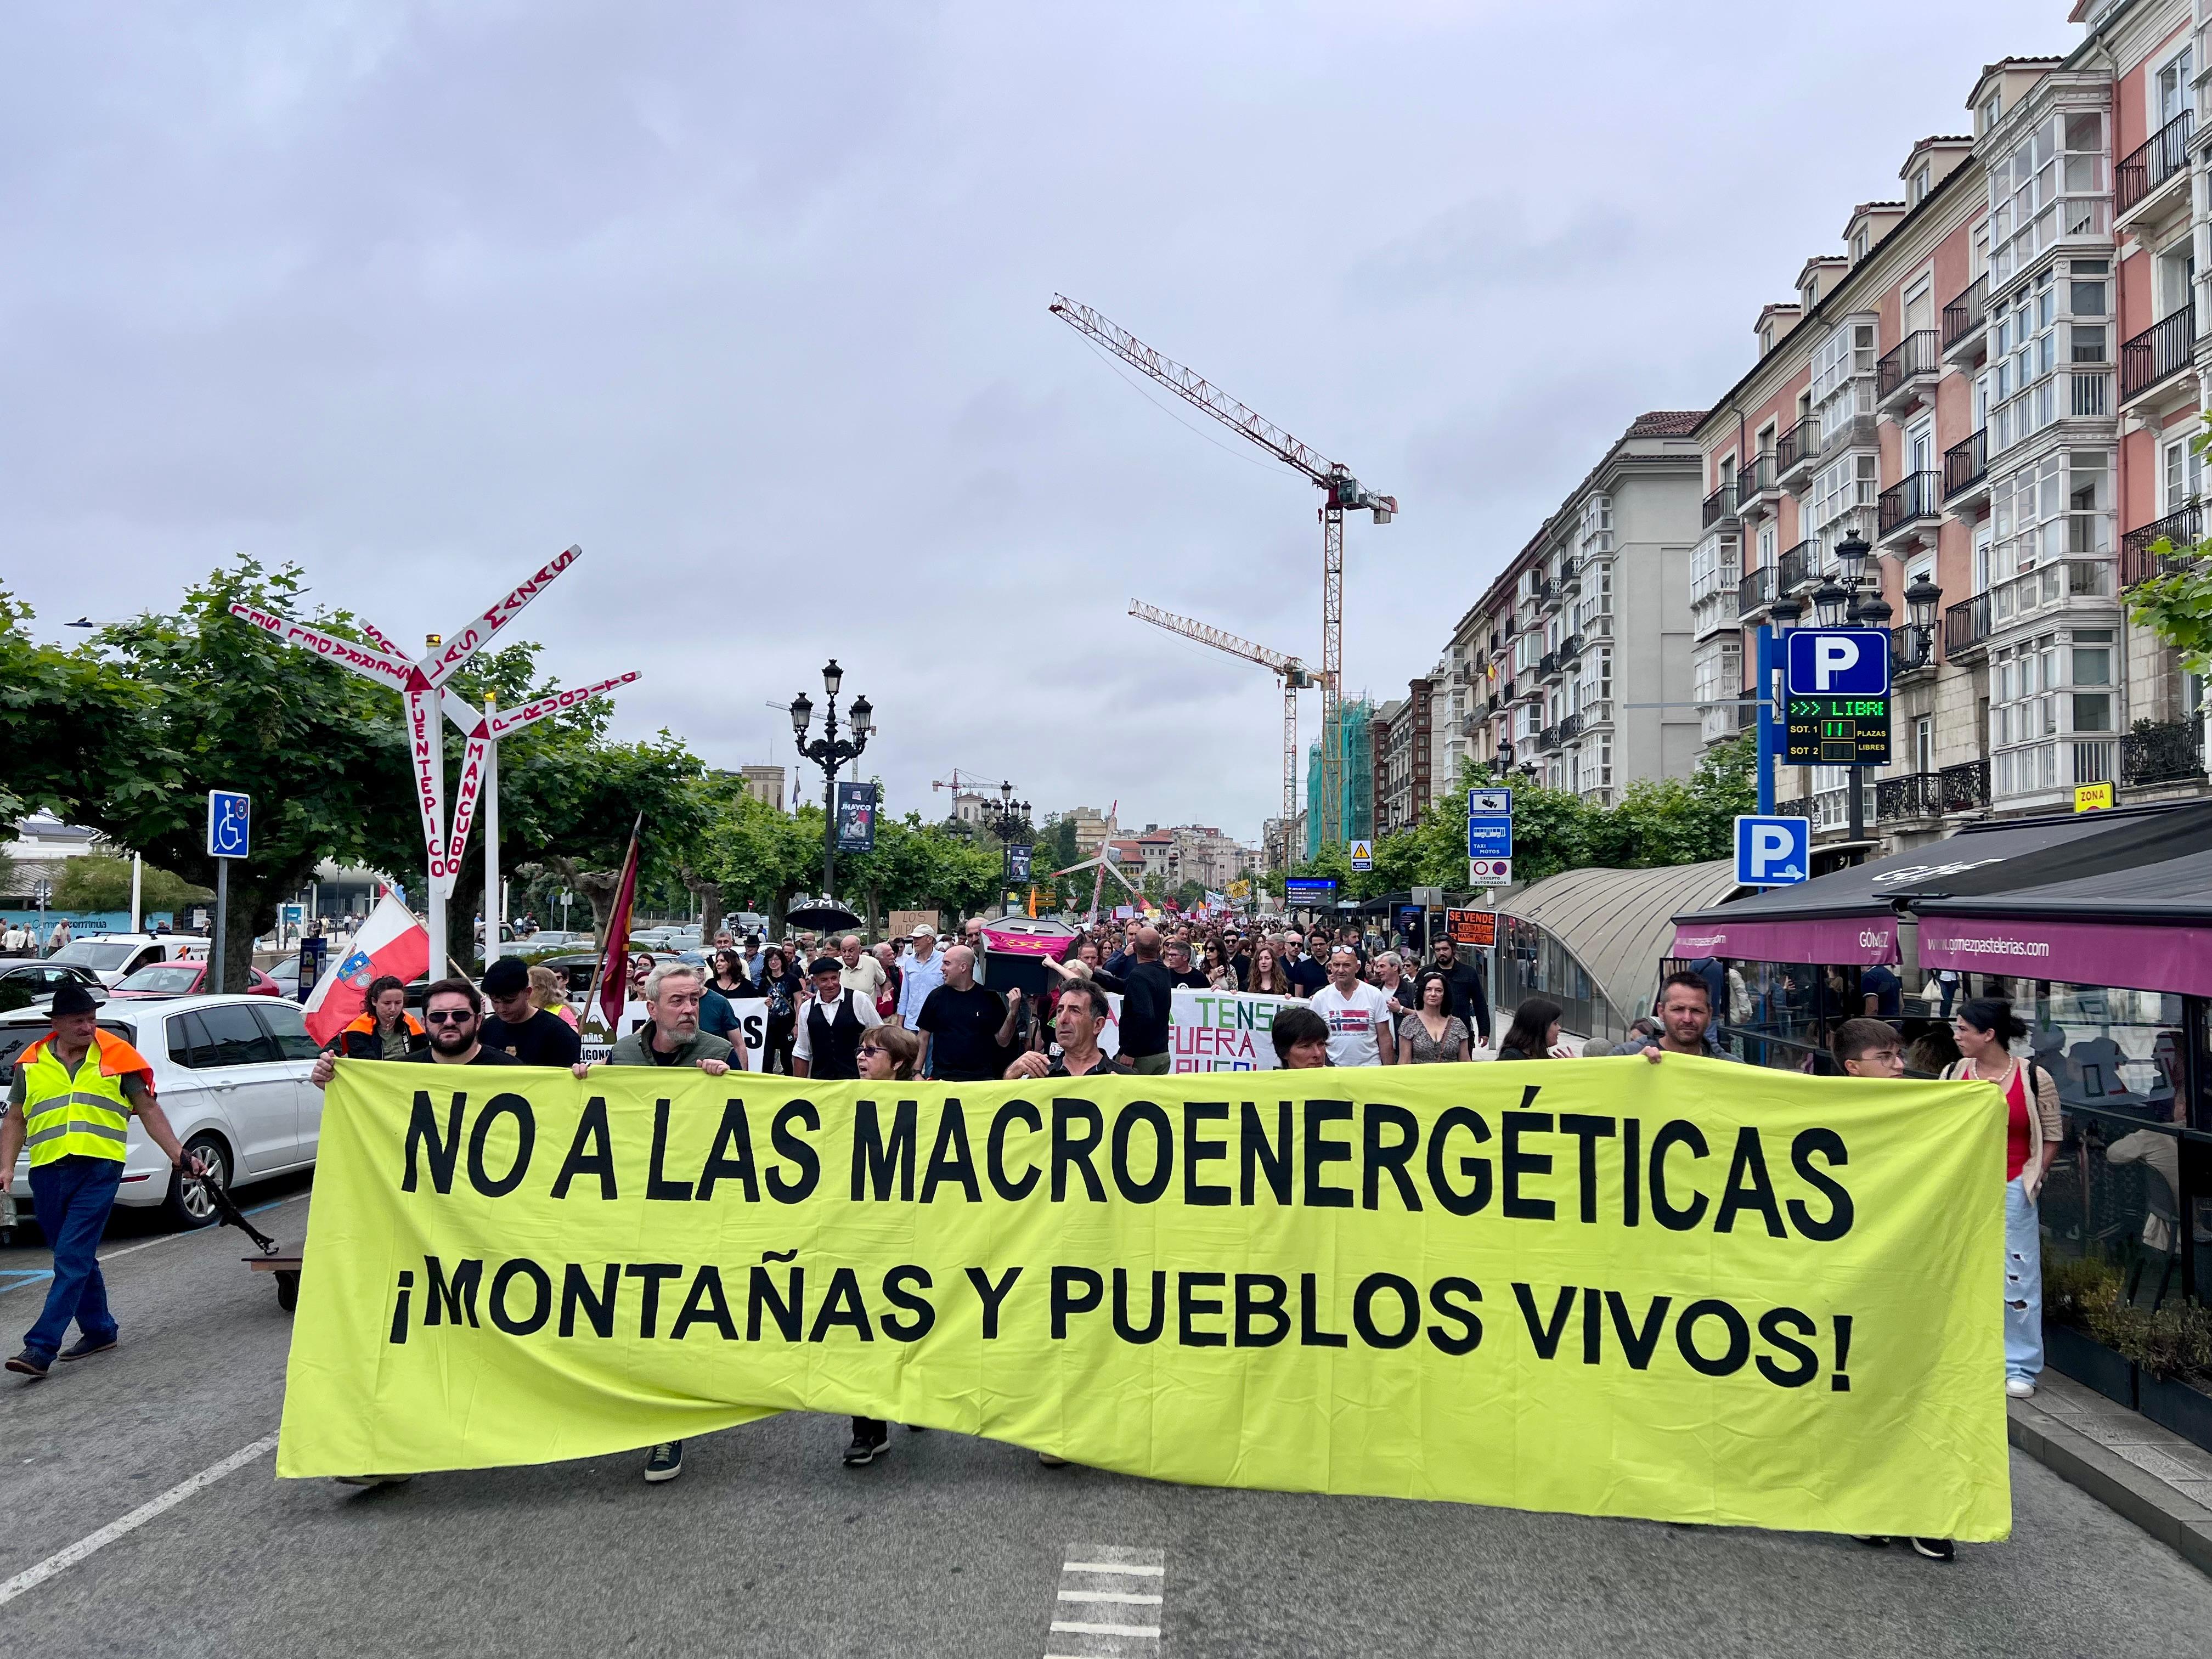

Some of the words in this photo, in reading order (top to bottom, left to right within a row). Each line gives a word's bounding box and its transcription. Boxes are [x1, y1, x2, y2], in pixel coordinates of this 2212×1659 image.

[430, 629, 478, 680] LAS
[1815, 637, 1859, 690] P
[493, 672, 636, 732] PIRUQUITO
[411, 692, 444, 877] FUENTEPICO
[447, 742, 483, 874] MANCUBO
[2081, 790, 2104, 802] ZONA
[1751, 825, 1795, 877] P
[902, 912, 926, 923] LOS
[1449, 911, 1460, 921] SE
[1464, 912, 1494, 924] VENDE
[401, 1091, 535, 1198] NO
[550, 1096, 618, 1200] A
[645, 1098, 821, 1204] LAS
[850, 1085, 1854, 1242] MACROENERGÉTICAS
[390, 1249, 935, 1344] ¡MONTAÑAS
[964, 1267, 1024, 1339] Y
[1050, 1266, 1483, 1356] PUEBLOS
[1510, 1283, 1853, 1392] VIVOS!
